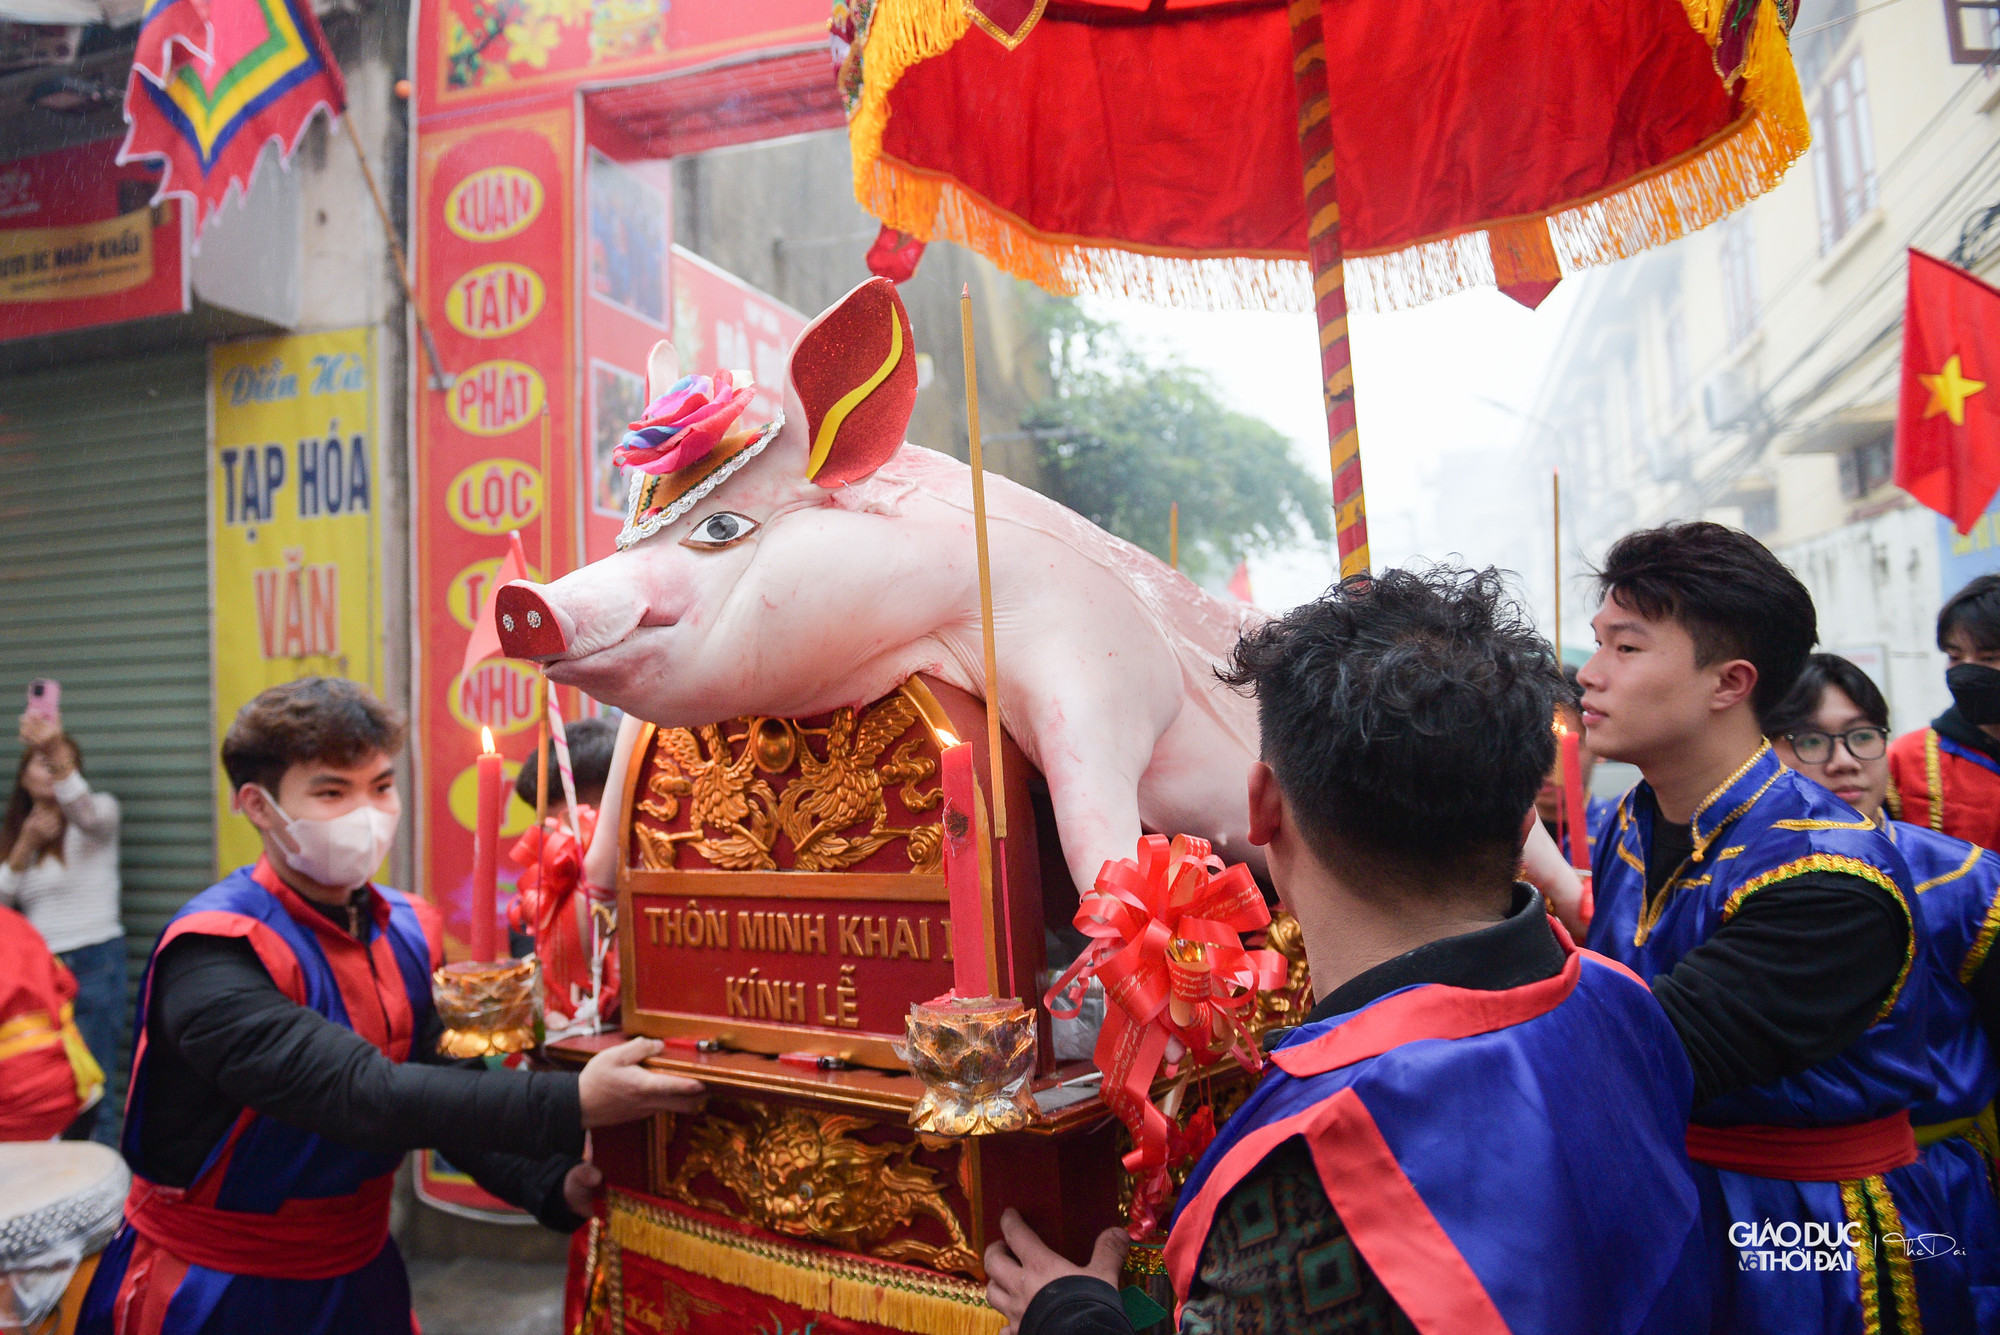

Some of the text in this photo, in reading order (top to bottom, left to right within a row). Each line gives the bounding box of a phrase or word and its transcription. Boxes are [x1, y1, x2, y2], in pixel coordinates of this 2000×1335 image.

[219, 418, 372, 542] TẠP HÓA
[459, 466, 533, 527] LỘC
[254, 547, 341, 660] VĂN
[644, 899, 728, 948] THÔN
[738, 911, 827, 955] MINH
[838, 914, 931, 961] KHAI
[726, 963, 860, 1029] KÍNH LỄ
